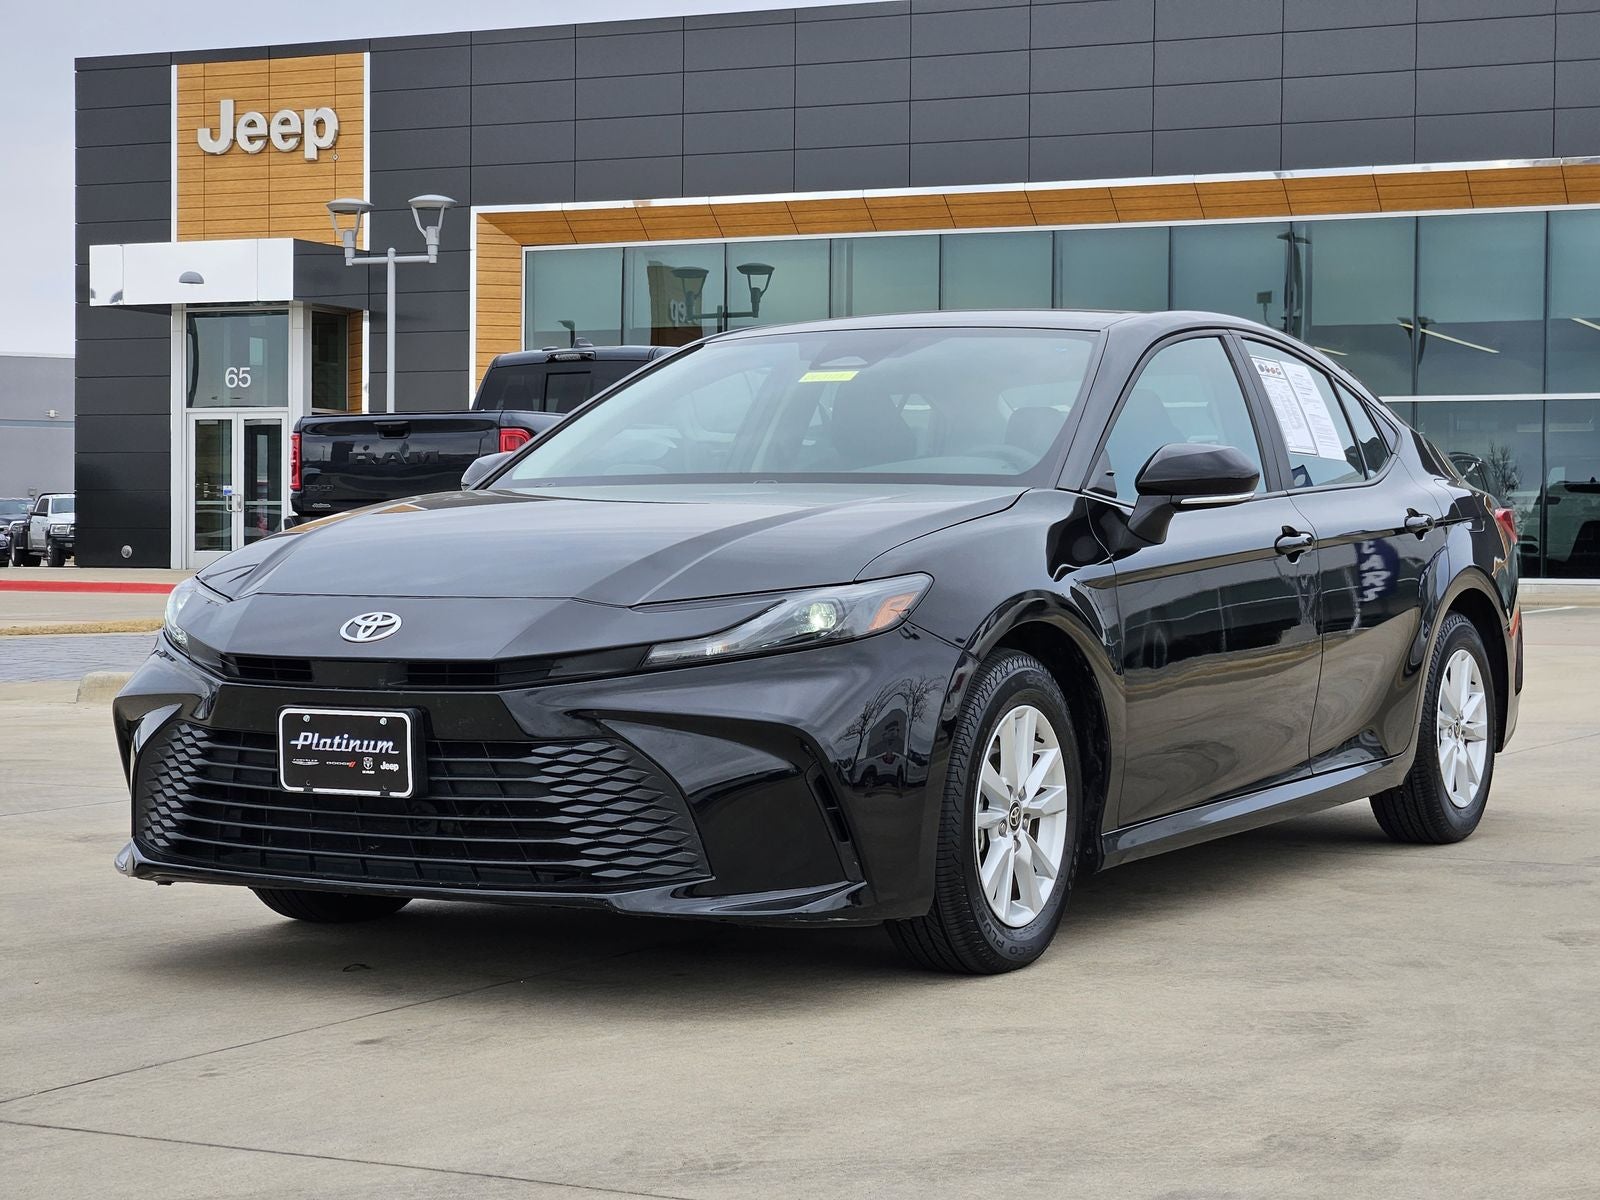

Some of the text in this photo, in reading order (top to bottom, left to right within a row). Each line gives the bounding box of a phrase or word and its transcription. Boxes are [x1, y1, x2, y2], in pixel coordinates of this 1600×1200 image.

[197, 99, 339, 161] Jeep
[225, 366, 251, 388] 65
[349, 451, 439, 465] RAM
[290, 732, 400, 754] Platinum
[380, 761, 399, 772] Jeep
